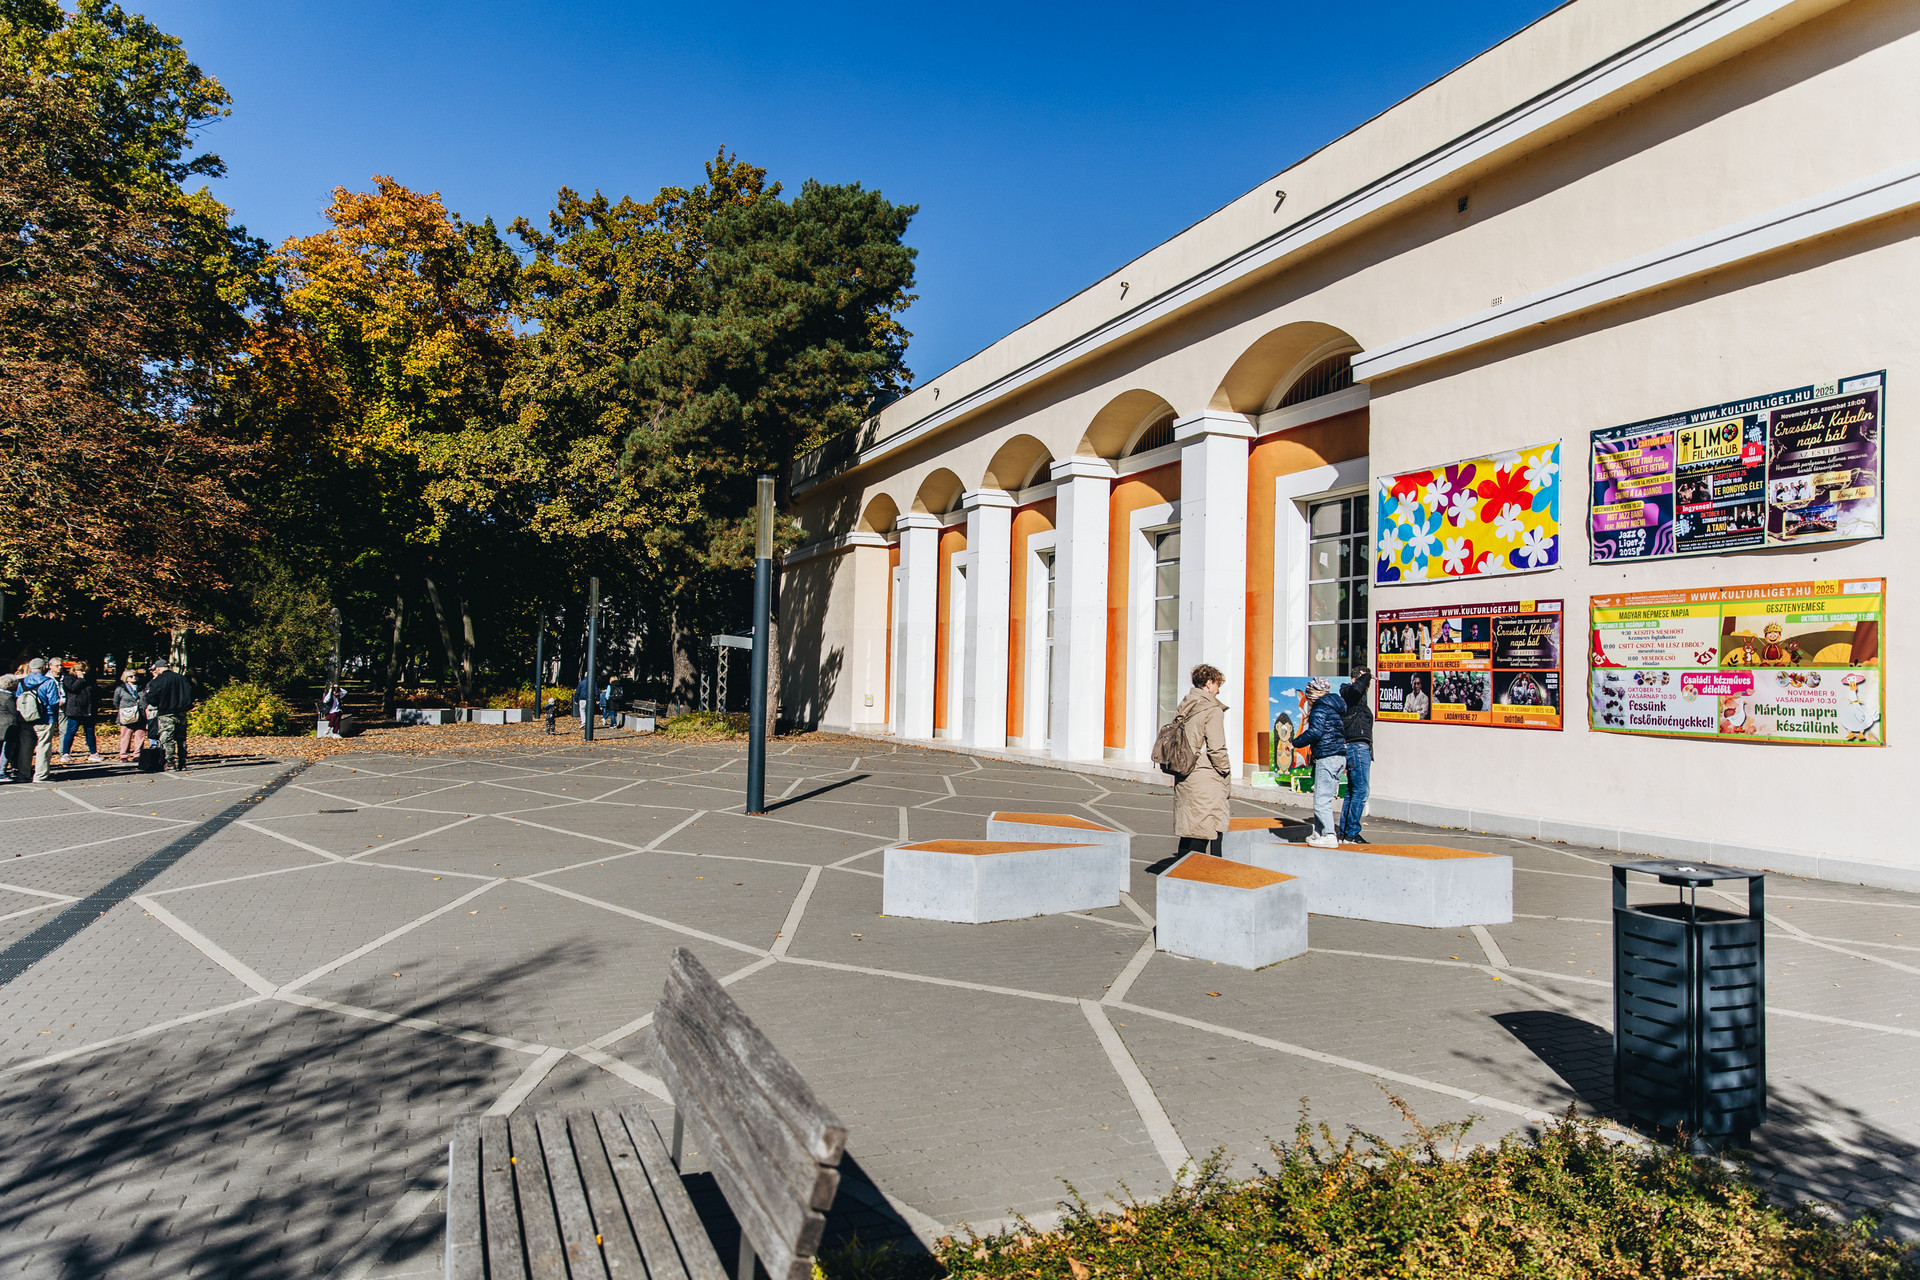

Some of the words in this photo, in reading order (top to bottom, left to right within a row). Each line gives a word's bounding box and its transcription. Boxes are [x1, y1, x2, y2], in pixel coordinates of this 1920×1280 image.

[1690, 390, 1810, 423] WWW.KULTURLIGET.HU
[1815, 386, 1836, 398] 2025.
[1781, 410, 1809, 420] November
[1821, 402, 1846, 412] szombat
[1774, 416, 1825, 437] Erzsébet,
[1828, 407, 1874, 427] Katalin
[1638, 439, 1660, 448] CARTOON
[1660, 435, 1672, 445] JAZZ
[1796, 434, 1823, 449] napi
[1824, 425, 1848, 442] bál
[1693, 444, 1738, 460] FILMKLUB
[1749, 446, 1756, 456] ÚJ
[1622, 458, 1640, 469] ISTVÁN
[1641, 454, 1653, 466] TRIÓ
[1742, 455, 1762, 463] PROGRAM
[1631, 465, 1648, 475] FEKETE
[1650, 461, 1669, 471] ISTVÁN
[1714, 471, 1740, 480] SZEPTEMBER
[1714, 487, 1721, 496] TE
[1722, 483, 1748, 494] RONGYOS
[1749, 480, 1763, 490] ÉLET
[1682, 502, 1712, 513] Ingyenes!
[1631, 510, 1643, 518] BAND
[1706, 524, 1711, 532] A
[1712, 522, 1727, 531] TANÚ
[1620, 548, 1636, 556] 2025
[1691, 586, 1811, 601] WWW.KULTURLIGET.HU
[1816, 585, 1836, 594] 2025.
[1442, 605, 1518, 616] WWW.KULTURLIGET.HU
[1766, 602, 1825, 613] GESZTENYEMESE
[1619, 611, 1642, 619] MAGYAR
[1643, 609, 1668, 618] NÉPMESE
[1671, 609, 1689, 617] NAPJA
[1830, 612, 1857, 621] VASÁRNAP
[1529, 624, 1555, 635] Katalin
[1510, 639, 1526, 649] napi
[1527, 635, 1540, 646] bál
[1684, 676, 1711, 684] Családi
[1714, 676, 1751, 685] kézműves
[1380, 686, 1403, 701] ZORÁN
[1702, 685, 1731, 694] délelőtt
[1380, 701, 1392, 709] TURNÉ
[1444, 712, 1470, 720] LADÁNYBENE
[1755, 704, 1795, 716] Márton
[1801, 708, 1837, 720] napra
[1630, 714, 1713, 730] festőnövényekkel!
[1777, 720, 1838, 733] készülünk
